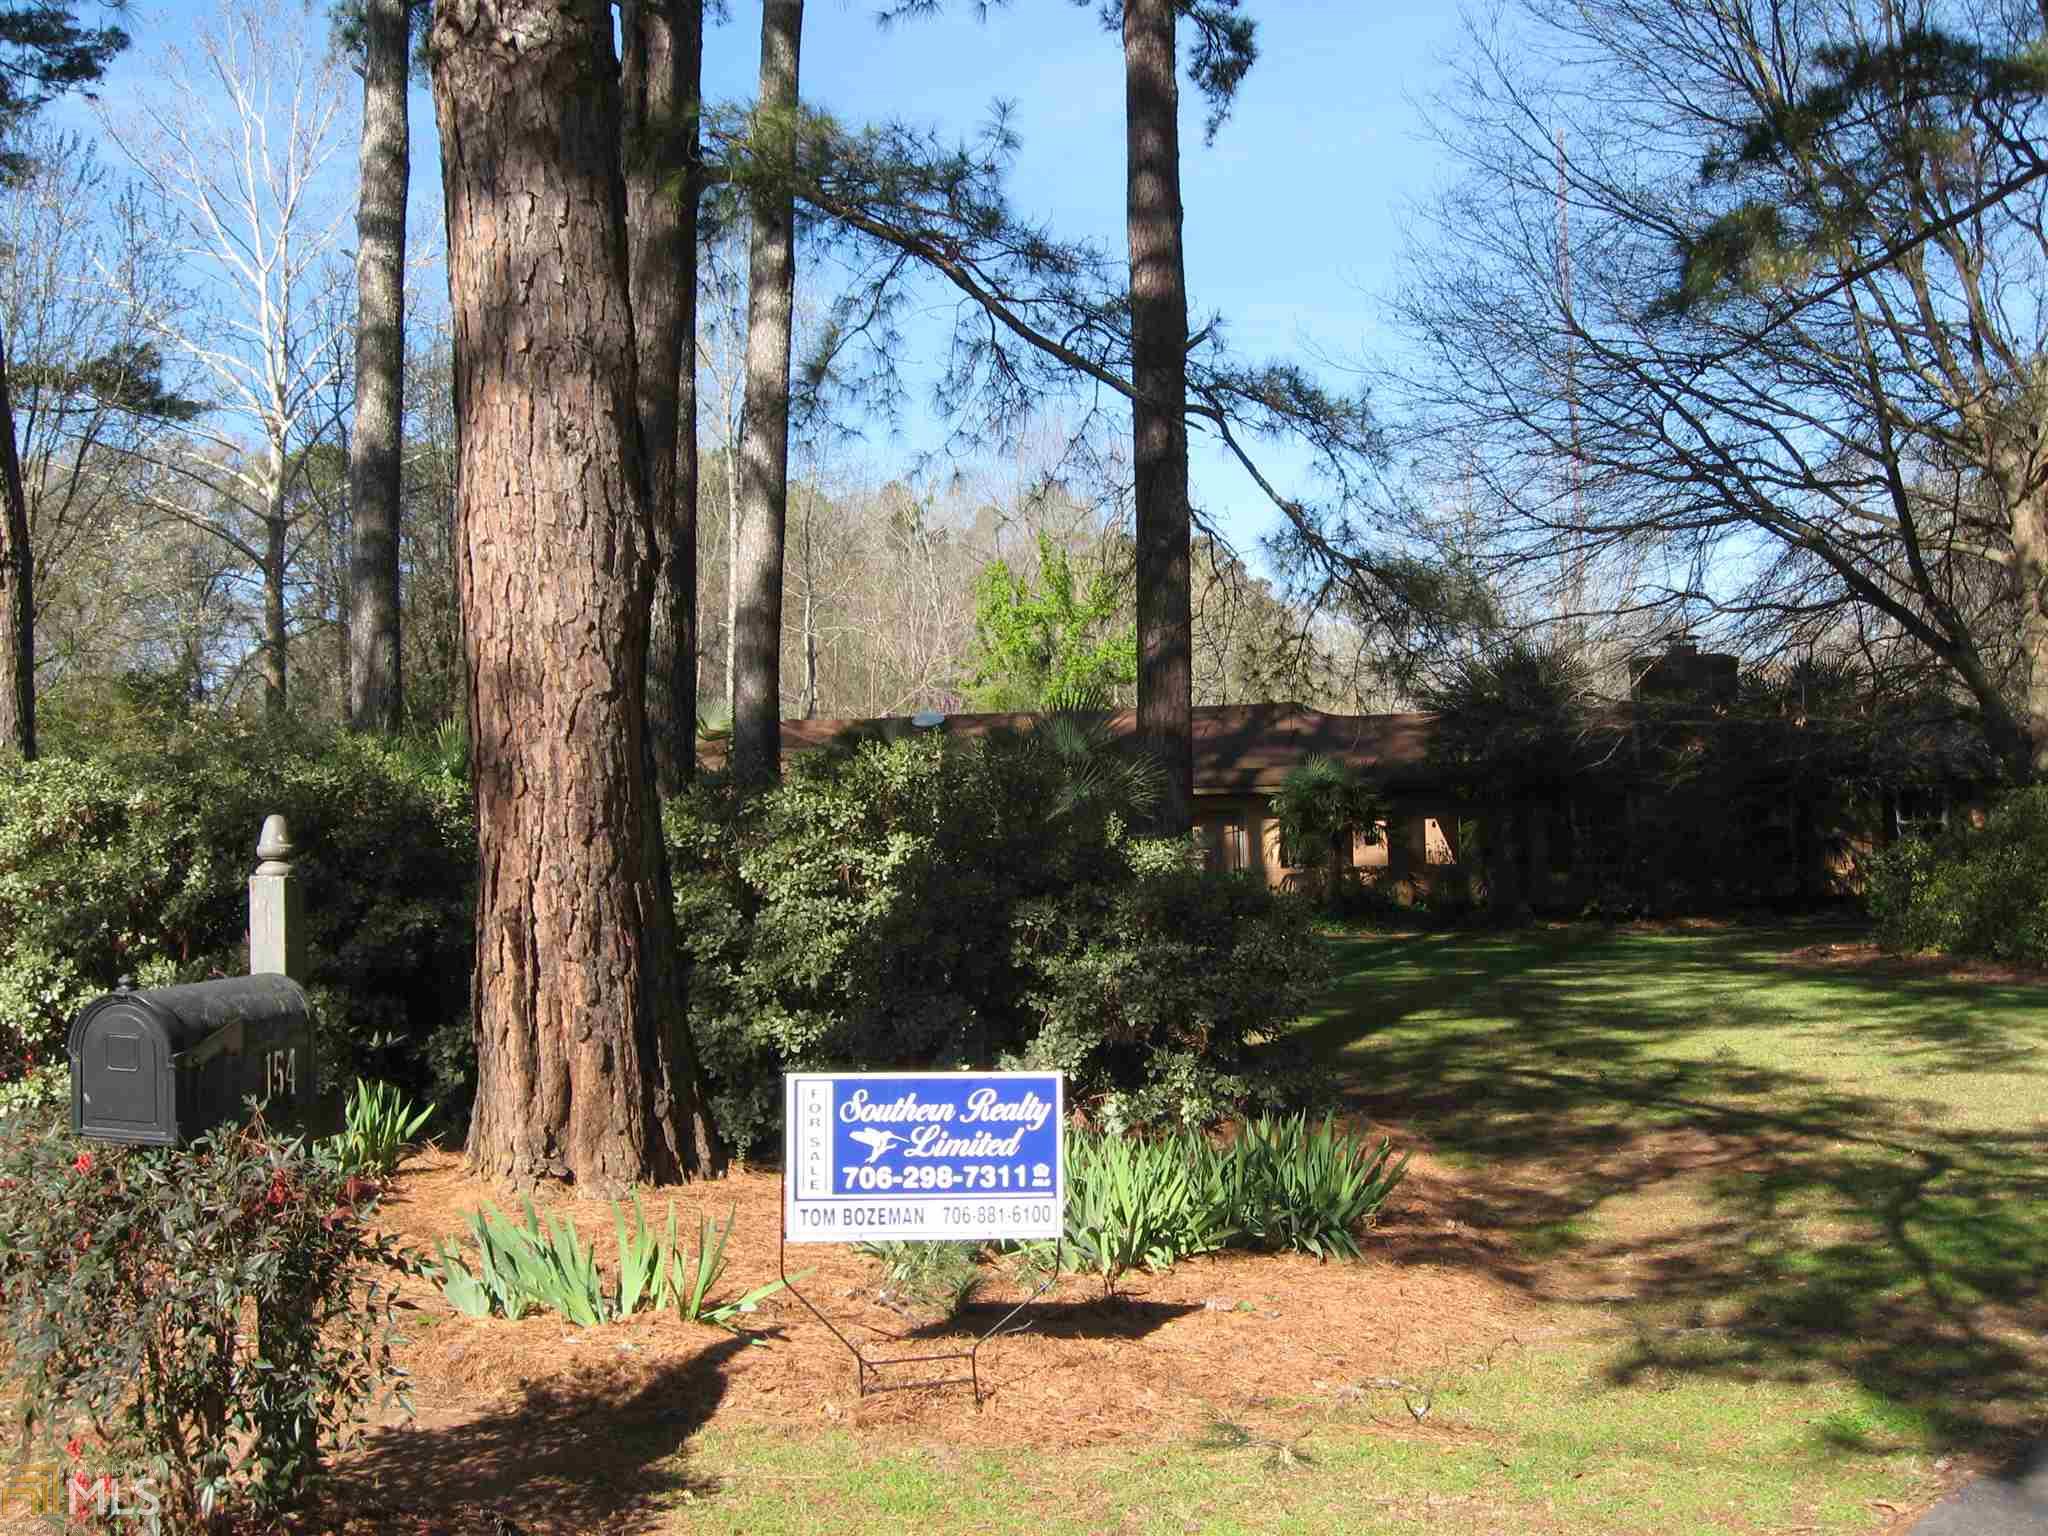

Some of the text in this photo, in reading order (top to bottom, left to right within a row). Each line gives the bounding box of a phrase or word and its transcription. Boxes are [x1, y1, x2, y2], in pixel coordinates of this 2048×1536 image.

[266, 1048, 296, 1100] 154
[839, 1087, 1052, 1131] Southern Realty
[808, 1088, 822, 1190] FOR SALE
[903, 1124, 1025, 1158] Limited
[842, 1163, 1026, 1189] 706-298-7311
[800, 1207, 836, 1227] TOM
[843, 1206, 925, 1226] BOZEMAN
